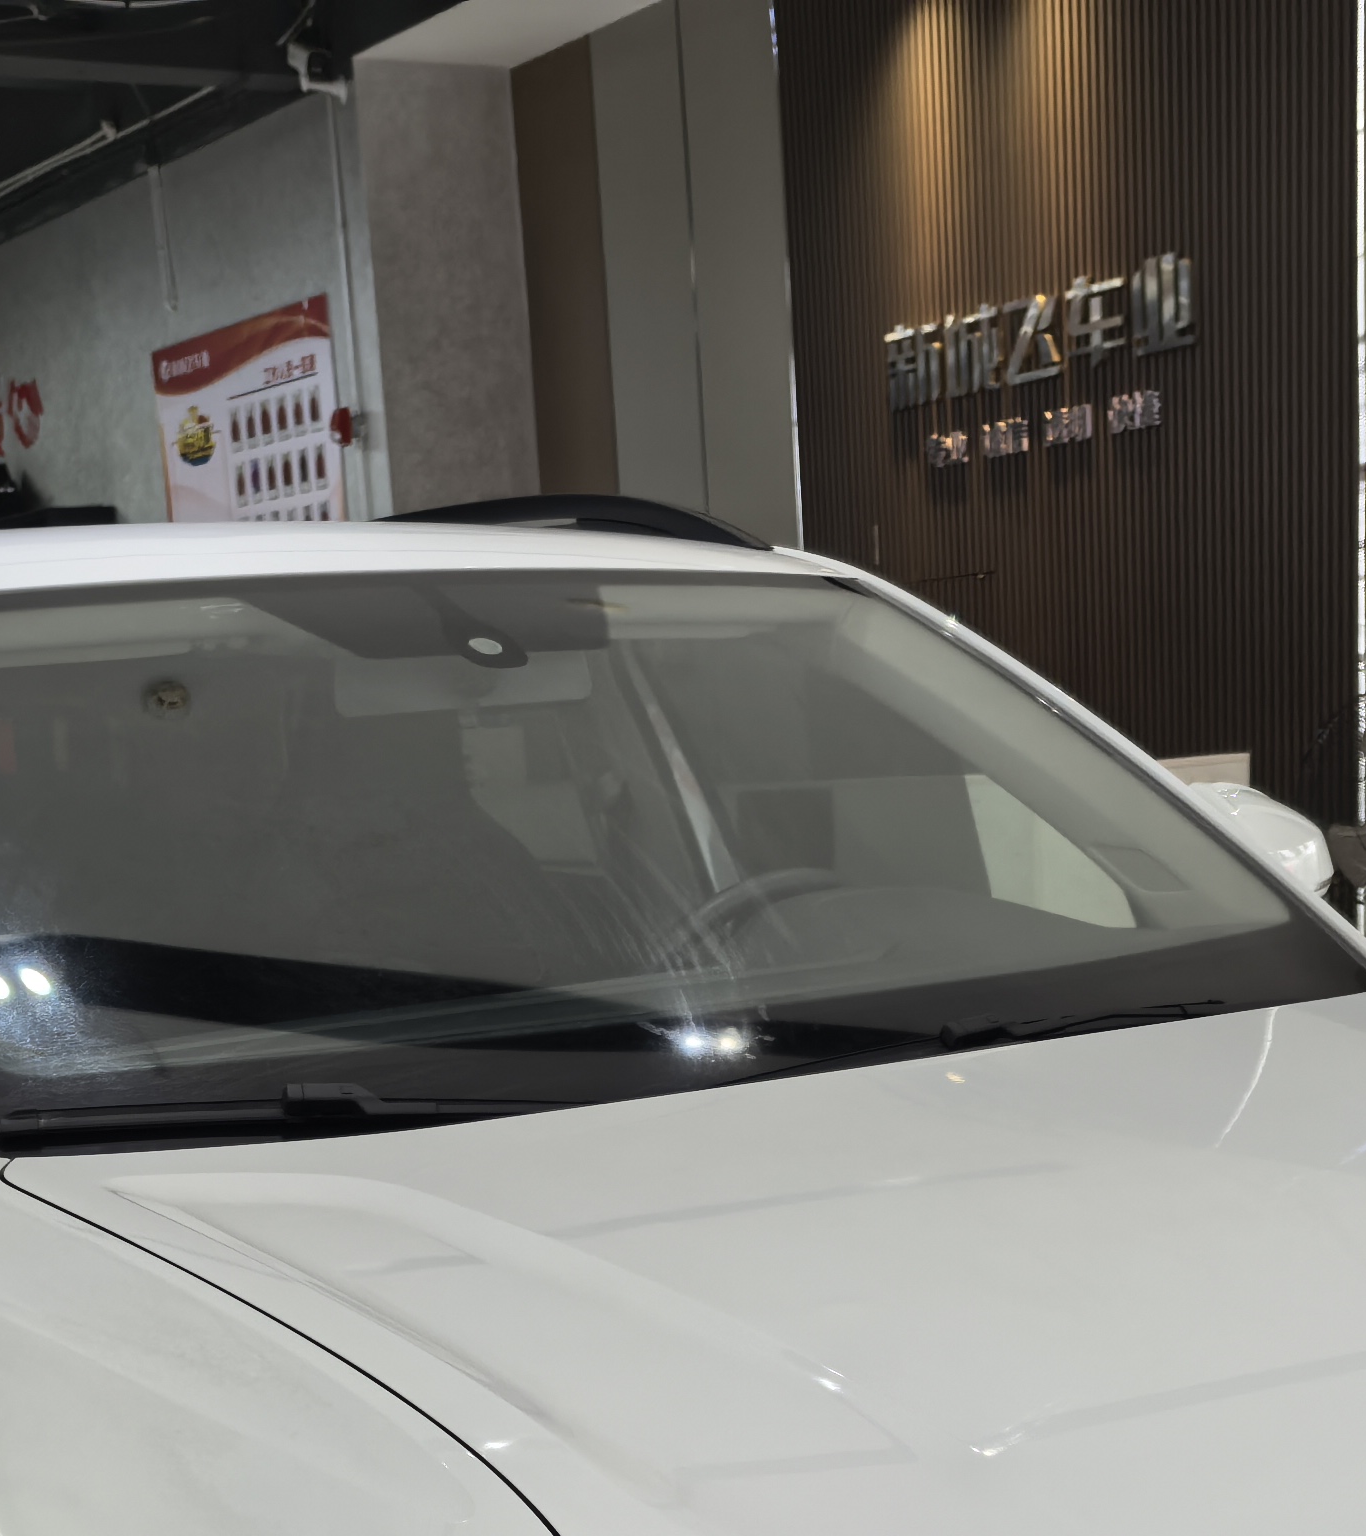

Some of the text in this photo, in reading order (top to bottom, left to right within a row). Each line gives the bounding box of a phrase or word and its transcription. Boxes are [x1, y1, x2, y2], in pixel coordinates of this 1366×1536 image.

[884, 251, 1196, 411] 新城飞车业
